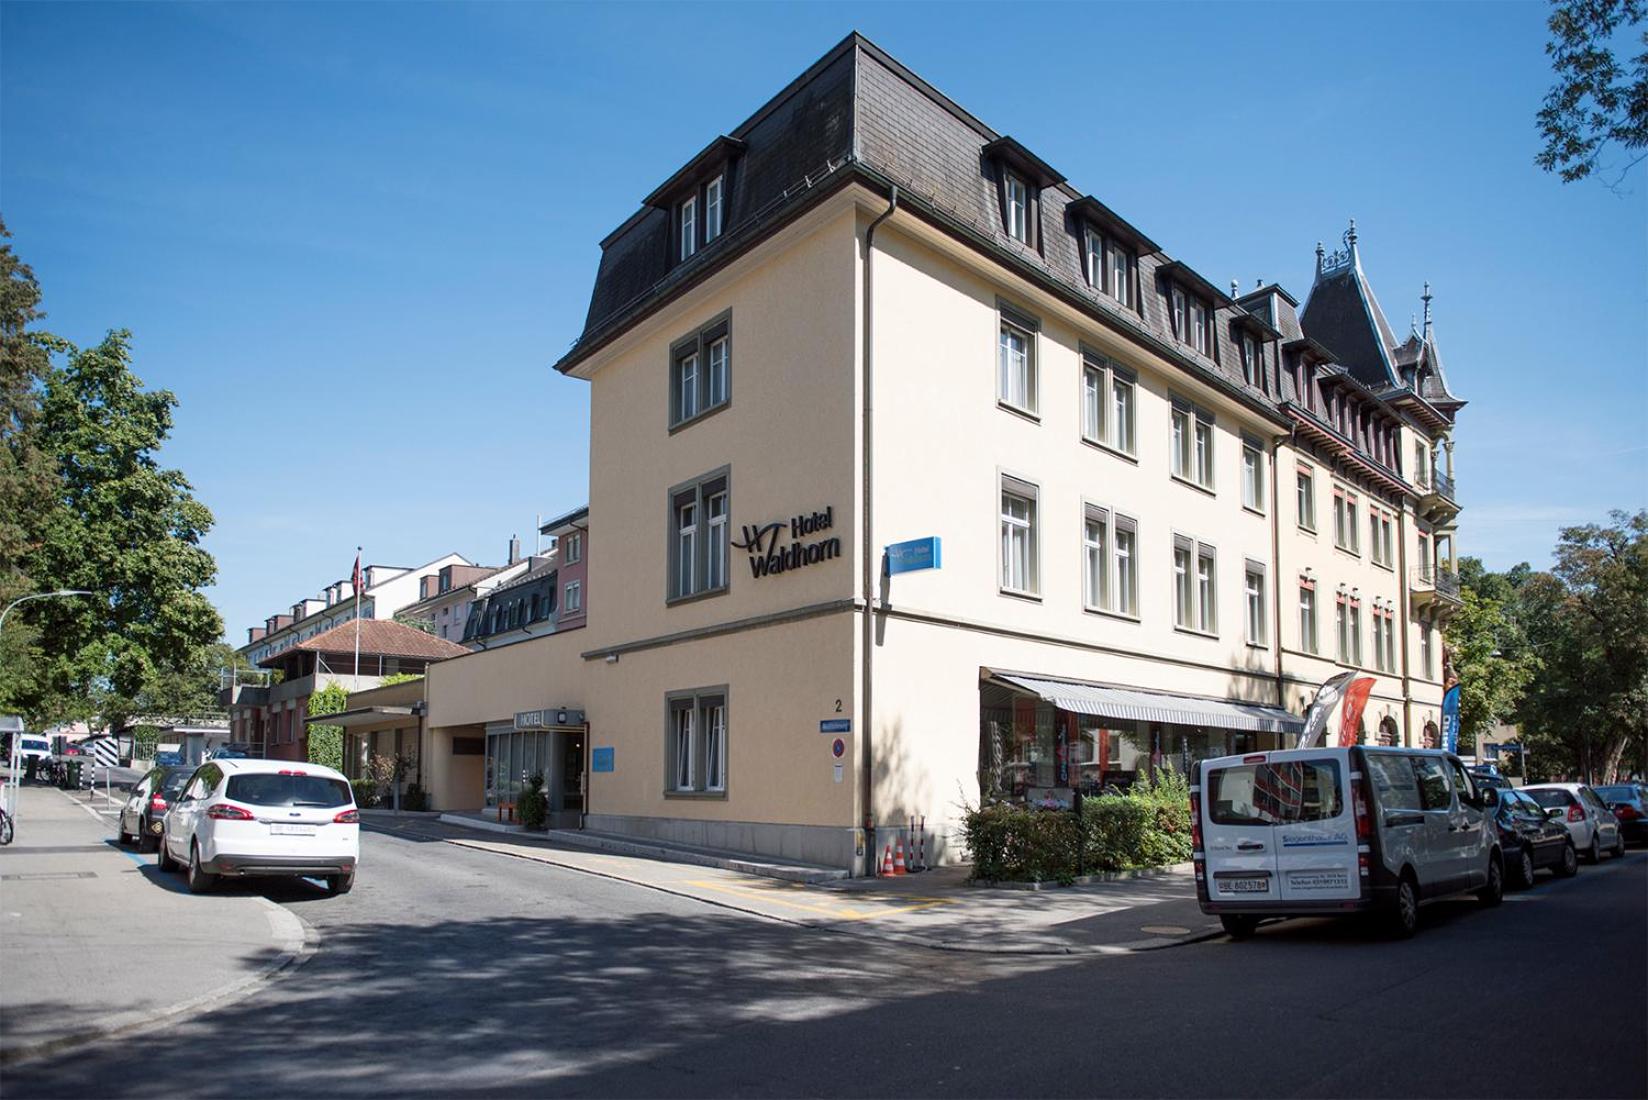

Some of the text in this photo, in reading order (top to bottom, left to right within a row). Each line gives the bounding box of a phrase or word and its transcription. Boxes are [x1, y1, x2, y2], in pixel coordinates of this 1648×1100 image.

[791, 506, 832, 539] Hotel
[749, 536, 841, 579] Waldhorn
[835, 699, 842, 712] 2
[520, 712, 541, 726] HOTEL
